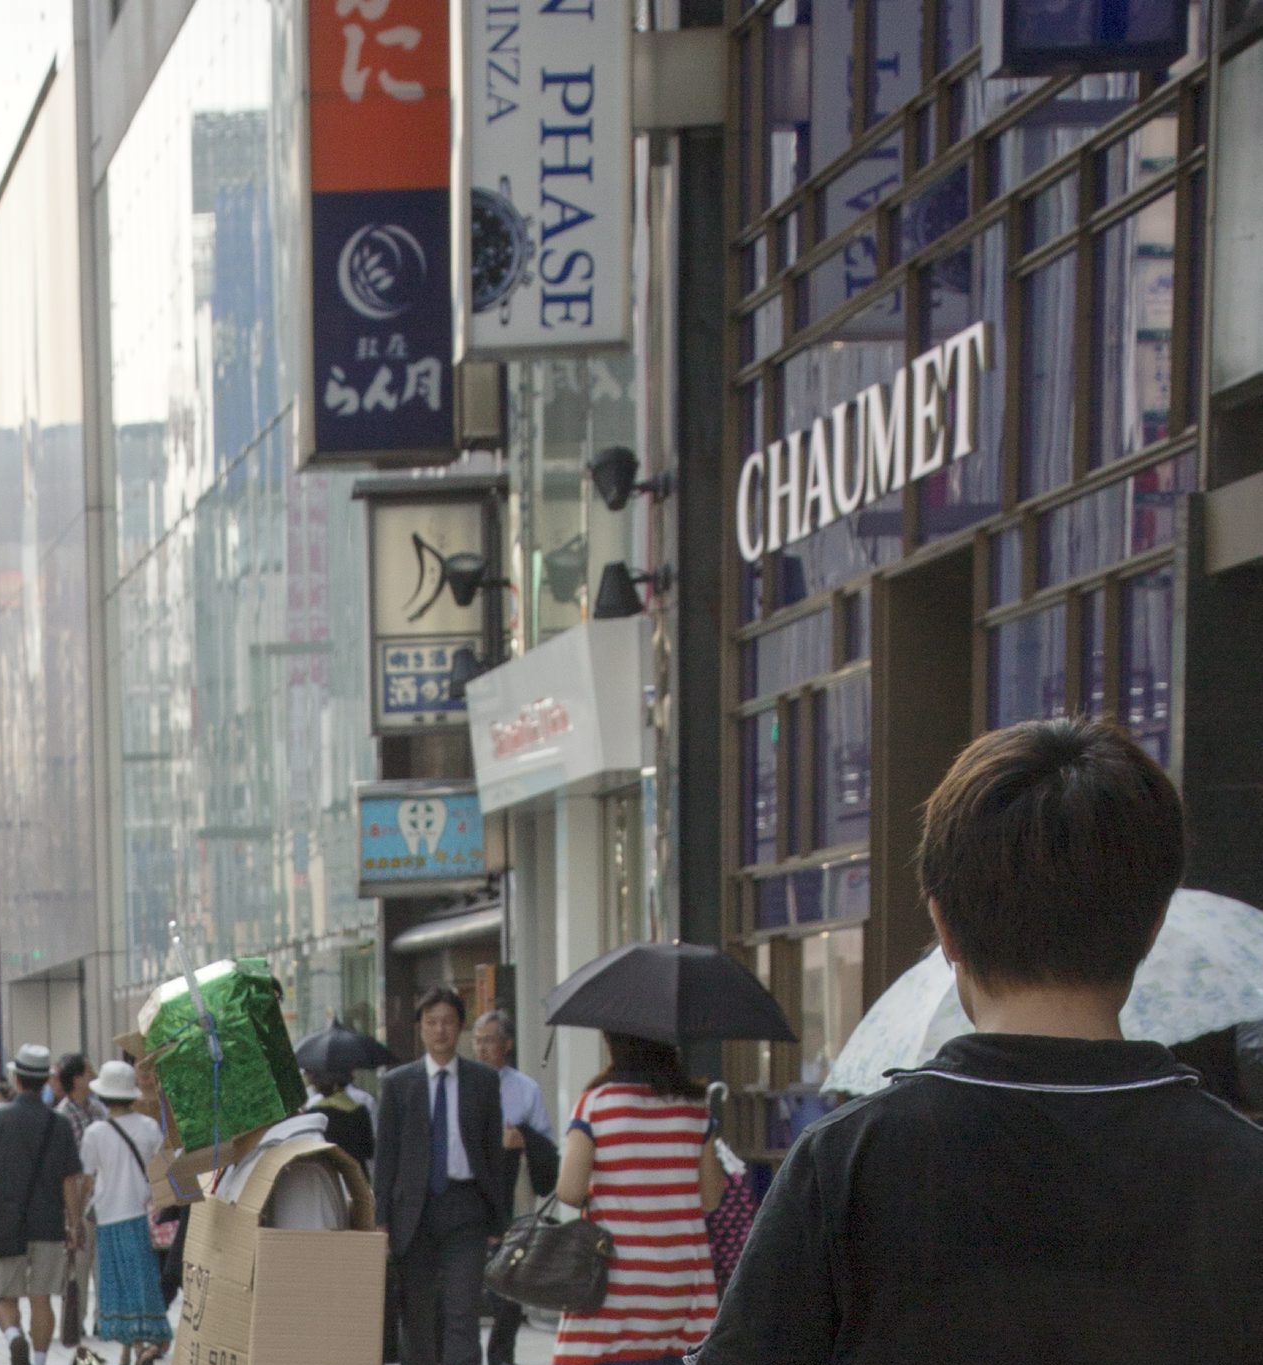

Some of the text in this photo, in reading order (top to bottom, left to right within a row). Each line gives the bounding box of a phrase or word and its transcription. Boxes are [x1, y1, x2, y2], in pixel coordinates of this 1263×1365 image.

[539, 65, 596, 329] PHASE
[325, 357, 442, 416] らん月
[736, 320, 989, 563] CHAUMET
